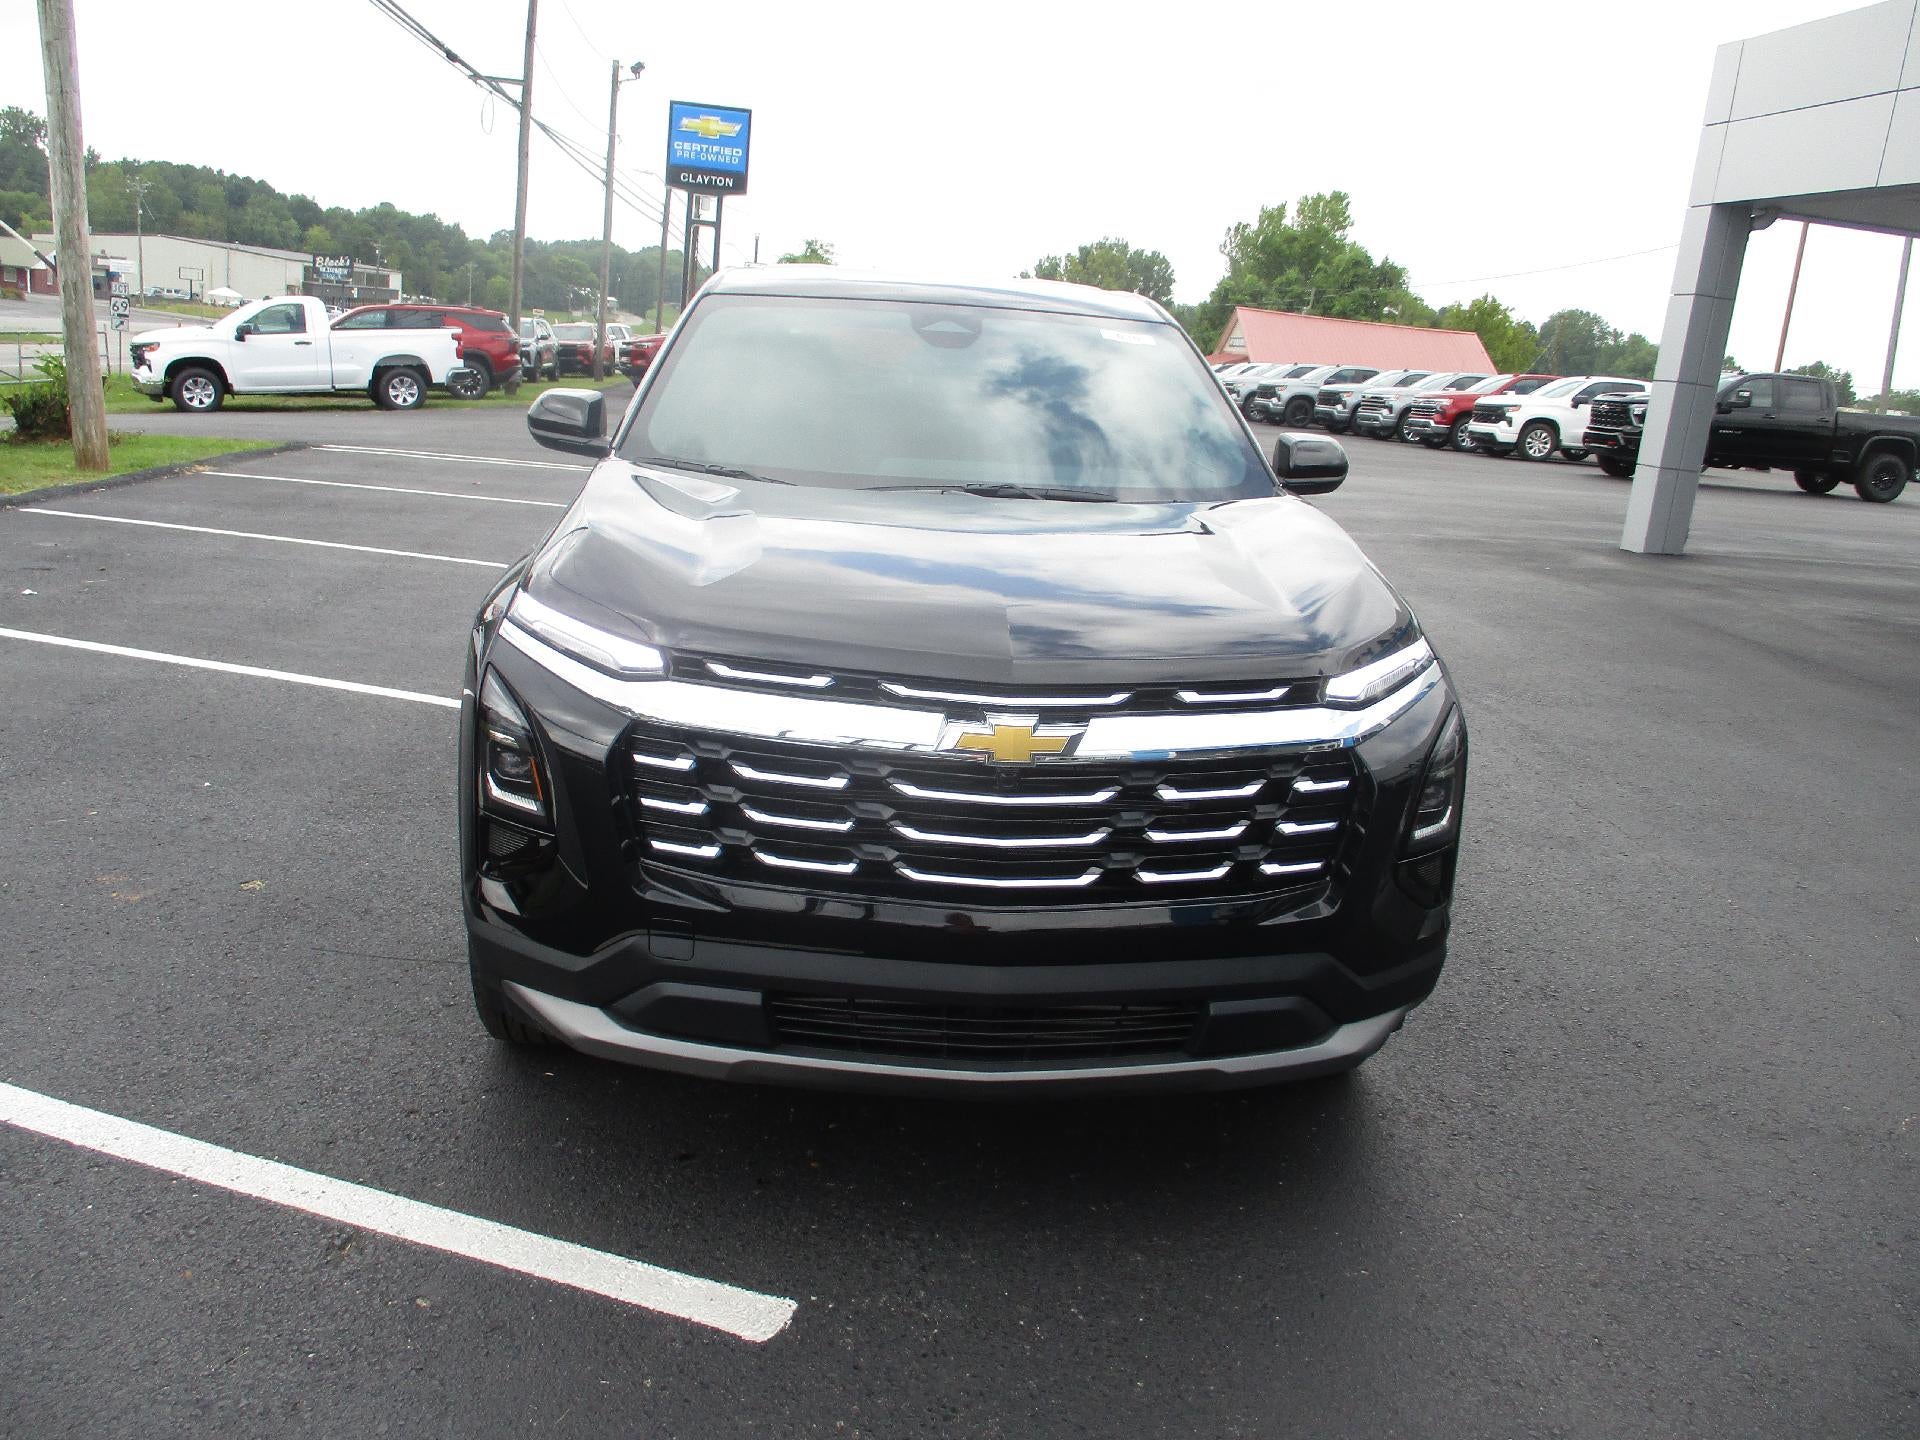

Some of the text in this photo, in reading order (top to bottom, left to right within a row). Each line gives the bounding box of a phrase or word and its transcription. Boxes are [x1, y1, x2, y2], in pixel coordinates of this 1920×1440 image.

[674, 141, 743, 157] CERTIFIED
[676, 150, 739, 164] PRE-OWNED
[680, 172, 734, 187] CLAYTON
[111, 283, 129, 295] JCT
[112, 300, 128, 312] 69
